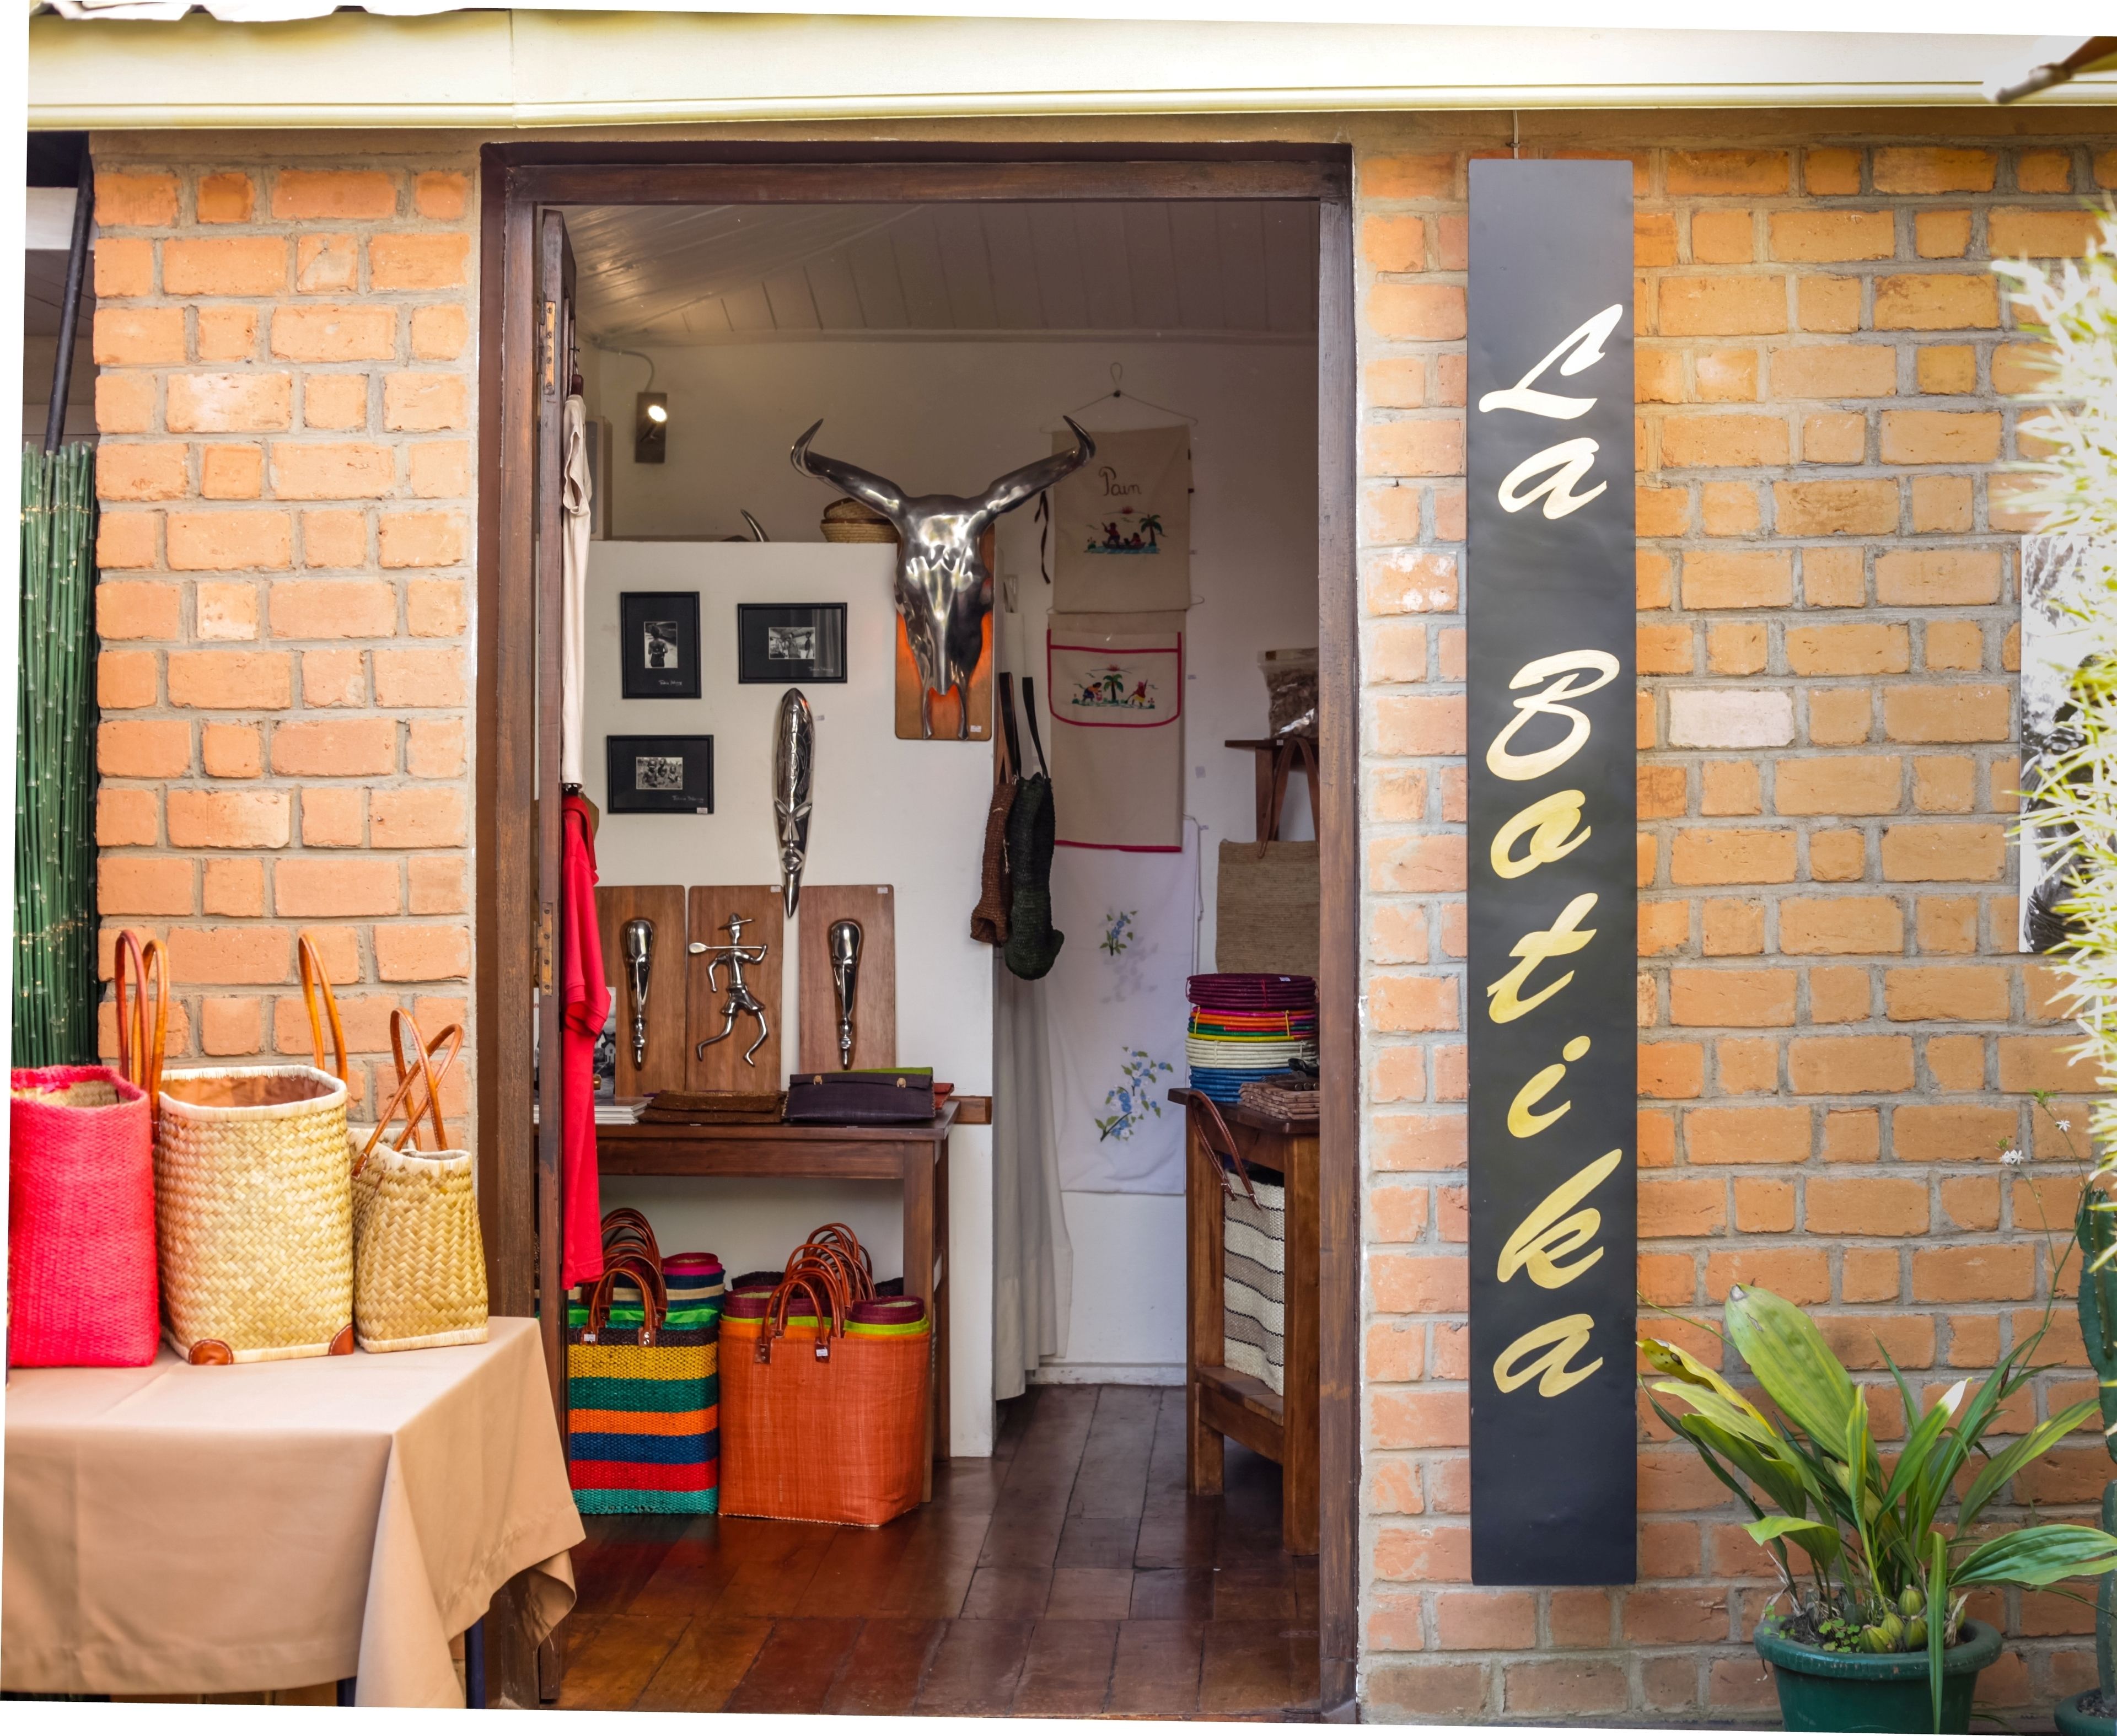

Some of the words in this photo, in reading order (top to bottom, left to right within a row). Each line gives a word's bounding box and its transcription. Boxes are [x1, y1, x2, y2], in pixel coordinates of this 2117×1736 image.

[1098, 466, 1142, 496] Pain
[1479, 304, 1623, 520] La
[1486, 649, 1622, 1398] Botika
